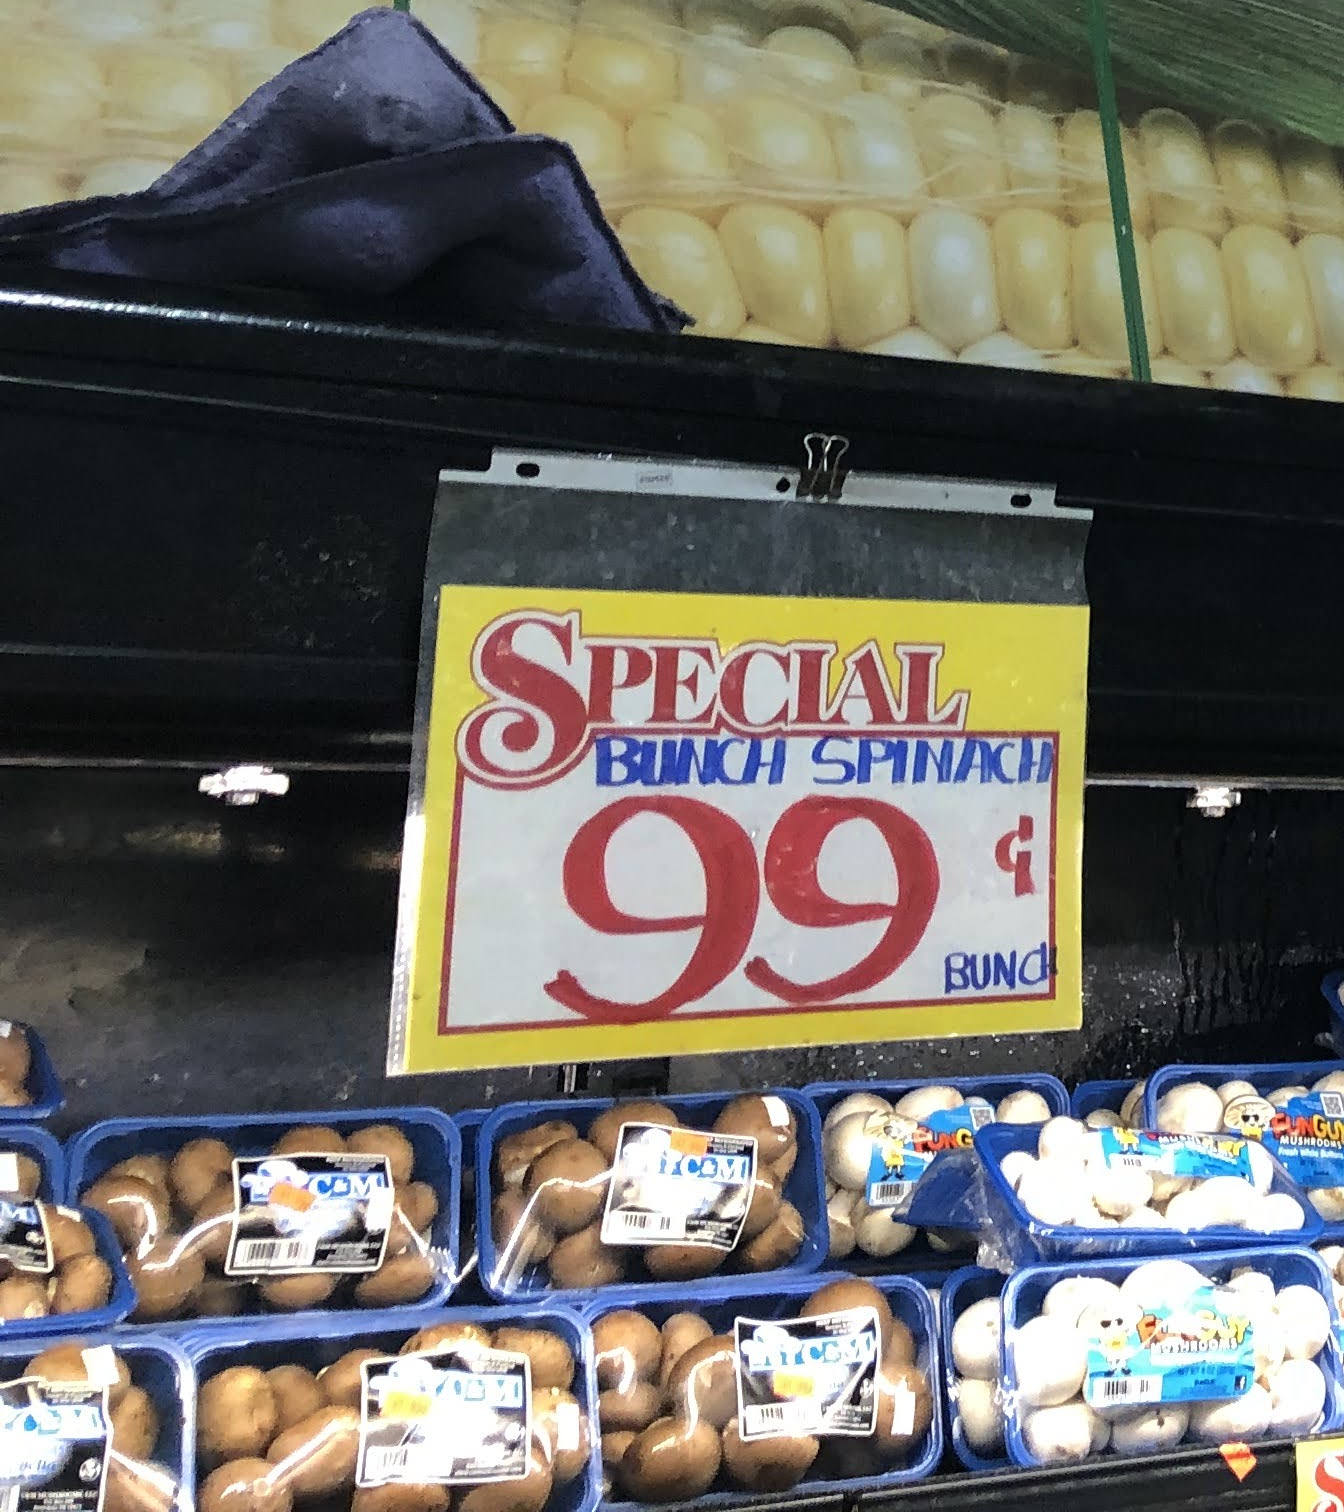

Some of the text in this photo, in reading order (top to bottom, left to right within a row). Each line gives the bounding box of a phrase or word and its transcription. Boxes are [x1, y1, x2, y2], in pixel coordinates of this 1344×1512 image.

[460, 612, 972, 784] SPECIAL
[595, 736, 1056, 786] BUNCH SPINACH
[911, 1124, 975, 1154] FUNG
[1279, 1134, 1343, 1150] MUSHROOMS
